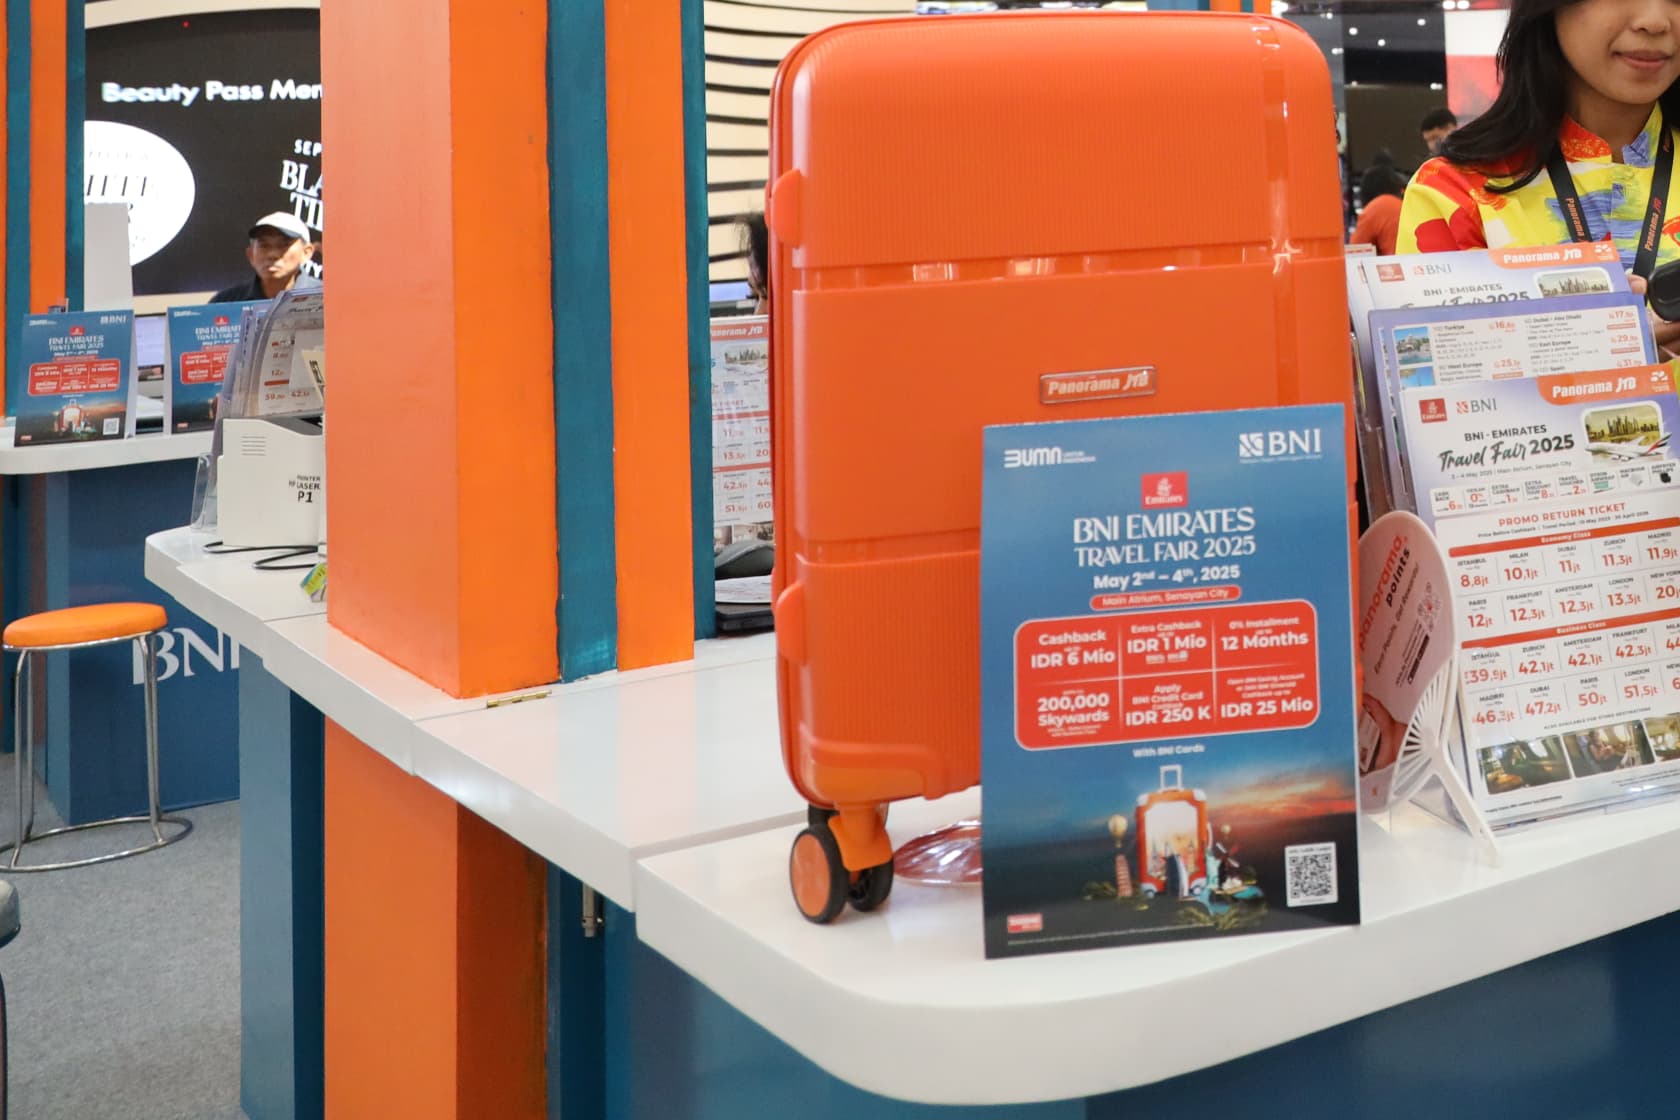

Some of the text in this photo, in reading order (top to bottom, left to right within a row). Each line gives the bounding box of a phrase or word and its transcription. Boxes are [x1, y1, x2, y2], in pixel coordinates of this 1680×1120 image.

[102, 82, 199, 106] Beauty
[206, 80, 264, 101] Pass
[1645, 212, 1659, 251] Panorama
[1503, 251, 1560, 264] Panorama
[1425, 264, 1452, 275] BNI
[1424, 283, 1503, 297] BNI EMIRATES
[1048, 378, 1120, 396] Panorama
[1552, 382, 1613, 398] Panorama
[1471, 398, 1497, 413] BNI
[1464, 424, 1547, 441] BNI EMIRATES
[1268, 428, 1321, 456] BNI
[1439, 434, 1574, 472] Travel Fair 2025
[1499, 515, 1539, 527] PROMO
[1542, 509, 1585, 523] RETURN
[1589, 502, 1626, 515] TICKET
[1074, 507, 1256, 544] BNI EMIRATES
[1074, 535, 1256, 568] TRAVEL FAIR 2025
[1504, 567, 1538, 581] 10,1jt
[1559, 560, 1581, 573] 11jt
[1094, 573, 1129, 591] May
[1200, 565, 1240, 580] 2025
[1386, 547, 1411, 607] points
[1102, 586, 1229, 606] Main Atrium, Senayan City
[1156, 620, 1202, 632] Cashback
[1468, 614, 1493, 628] 12jt
[1039, 629, 1106, 647] Cashback
[1127, 635, 1207, 653] IDR 1 Mio
[1221, 631, 1309, 651] 12 Months
[133, 628, 239, 685] BNI
[1031, 648, 1116, 669] IDR 6 Mio
[1151, 693, 1179, 704] Credit
[1181, 691, 1203, 702] Card
[1153, 683, 1182, 695] Apply
[1037, 693, 1110, 713] 200,000
[1221, 697, 1313, 719] IDR 25 Mio
[1578, 692, 1607, 706] 50jt
[1038, 710, 1110, 729] Skywards
[1126, 706, 1212, 726] IDR 250 K
[1175, 744, 1205, 755] Cards
